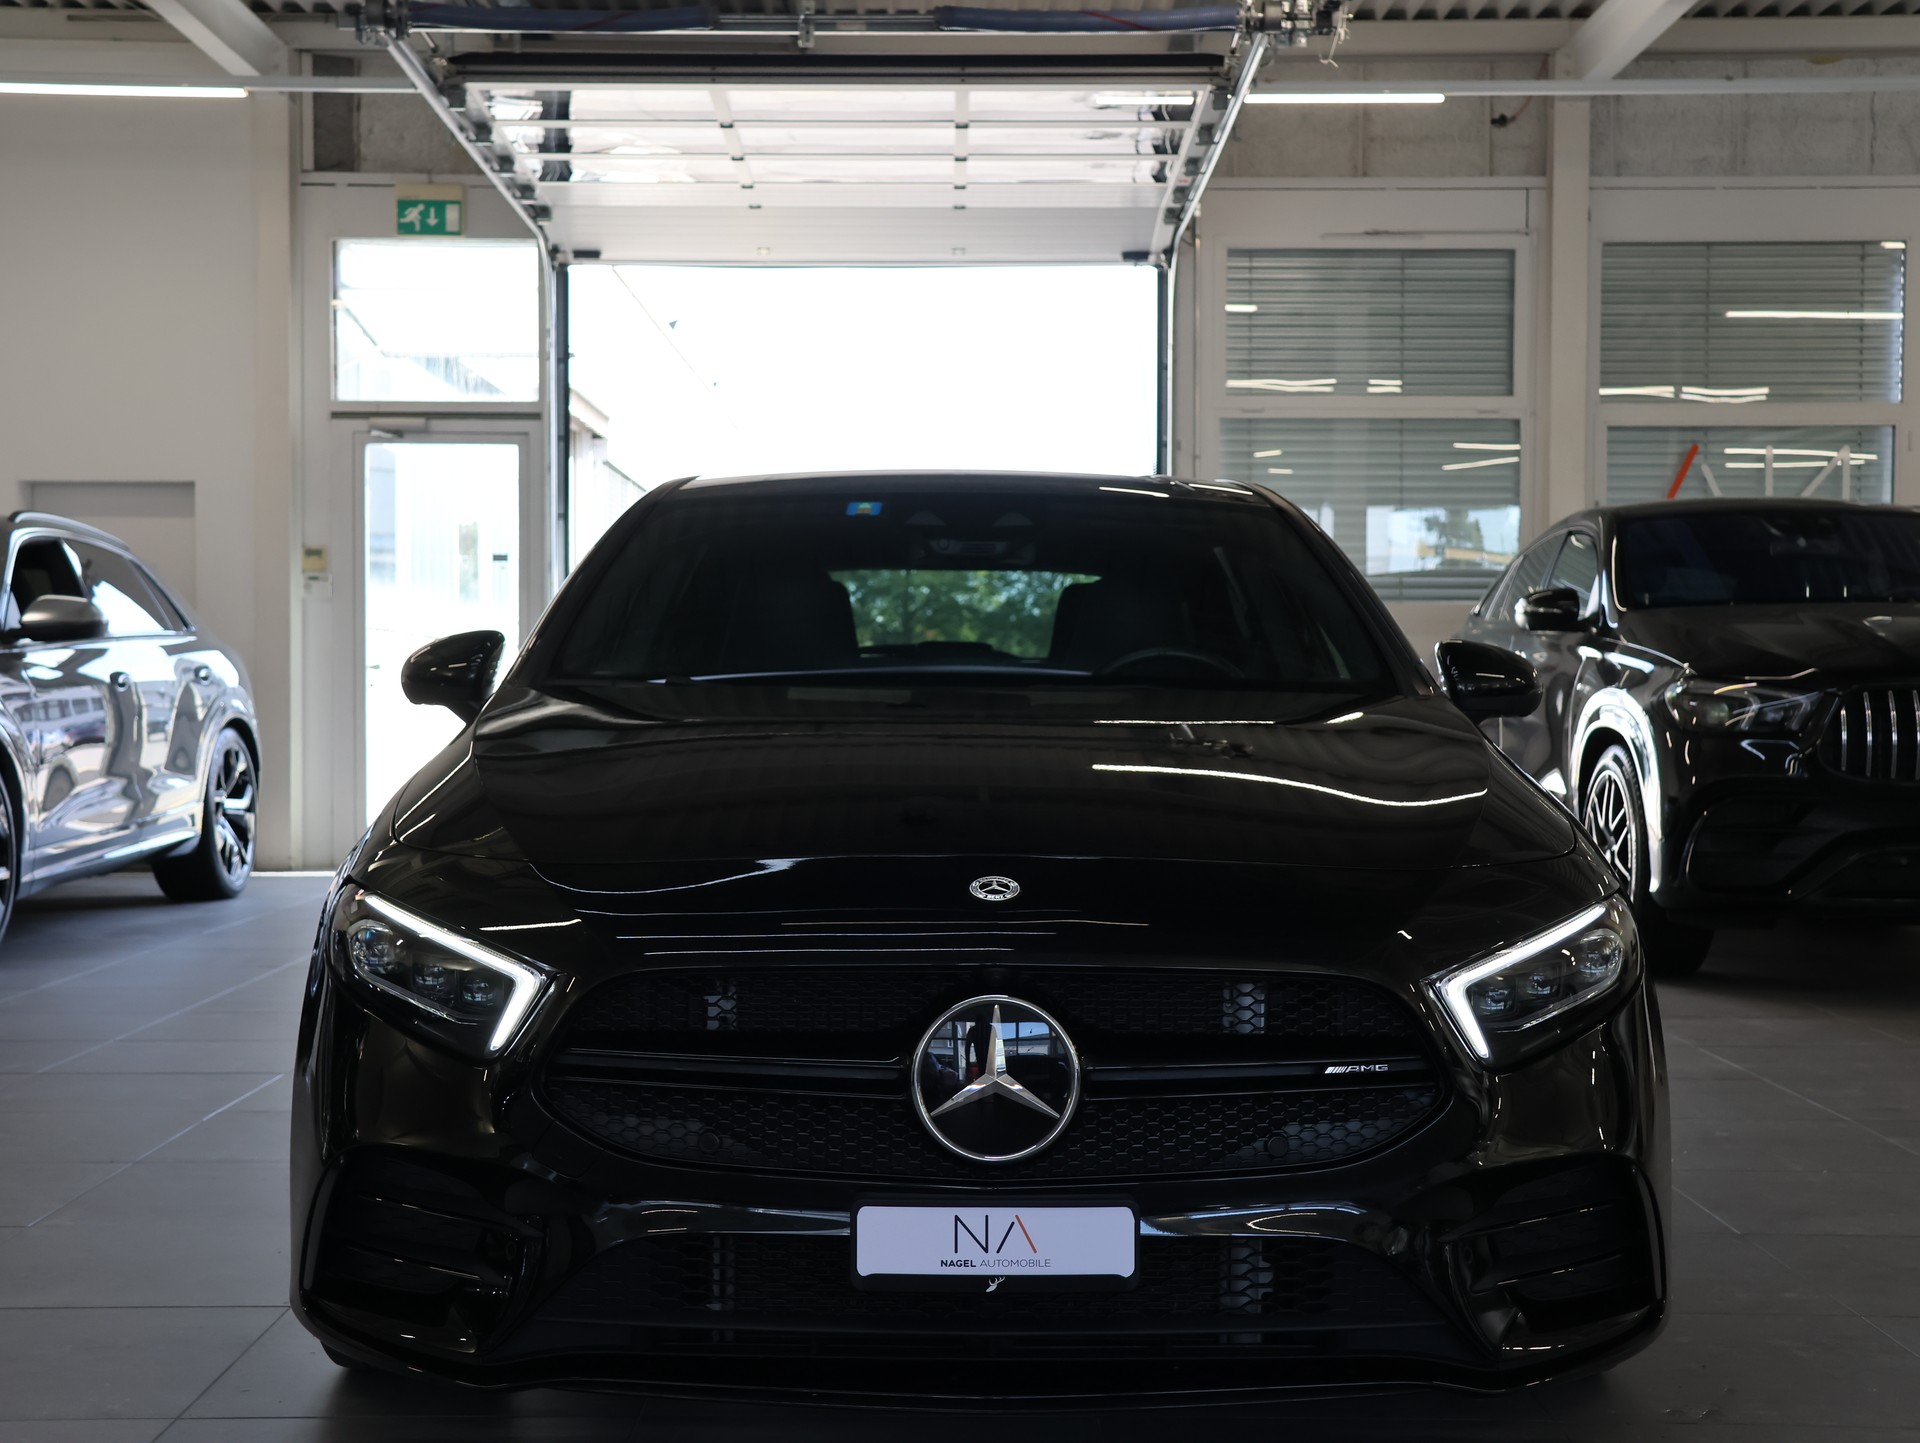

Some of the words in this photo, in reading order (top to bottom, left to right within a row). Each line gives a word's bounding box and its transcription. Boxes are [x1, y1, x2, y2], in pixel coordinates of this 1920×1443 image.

[1345, 1064, 1388, 1073] AMG
[940, 1259, 977, 1268] NAGEL
[979, 1259, 1052, 1268] AUTOMOBILE
